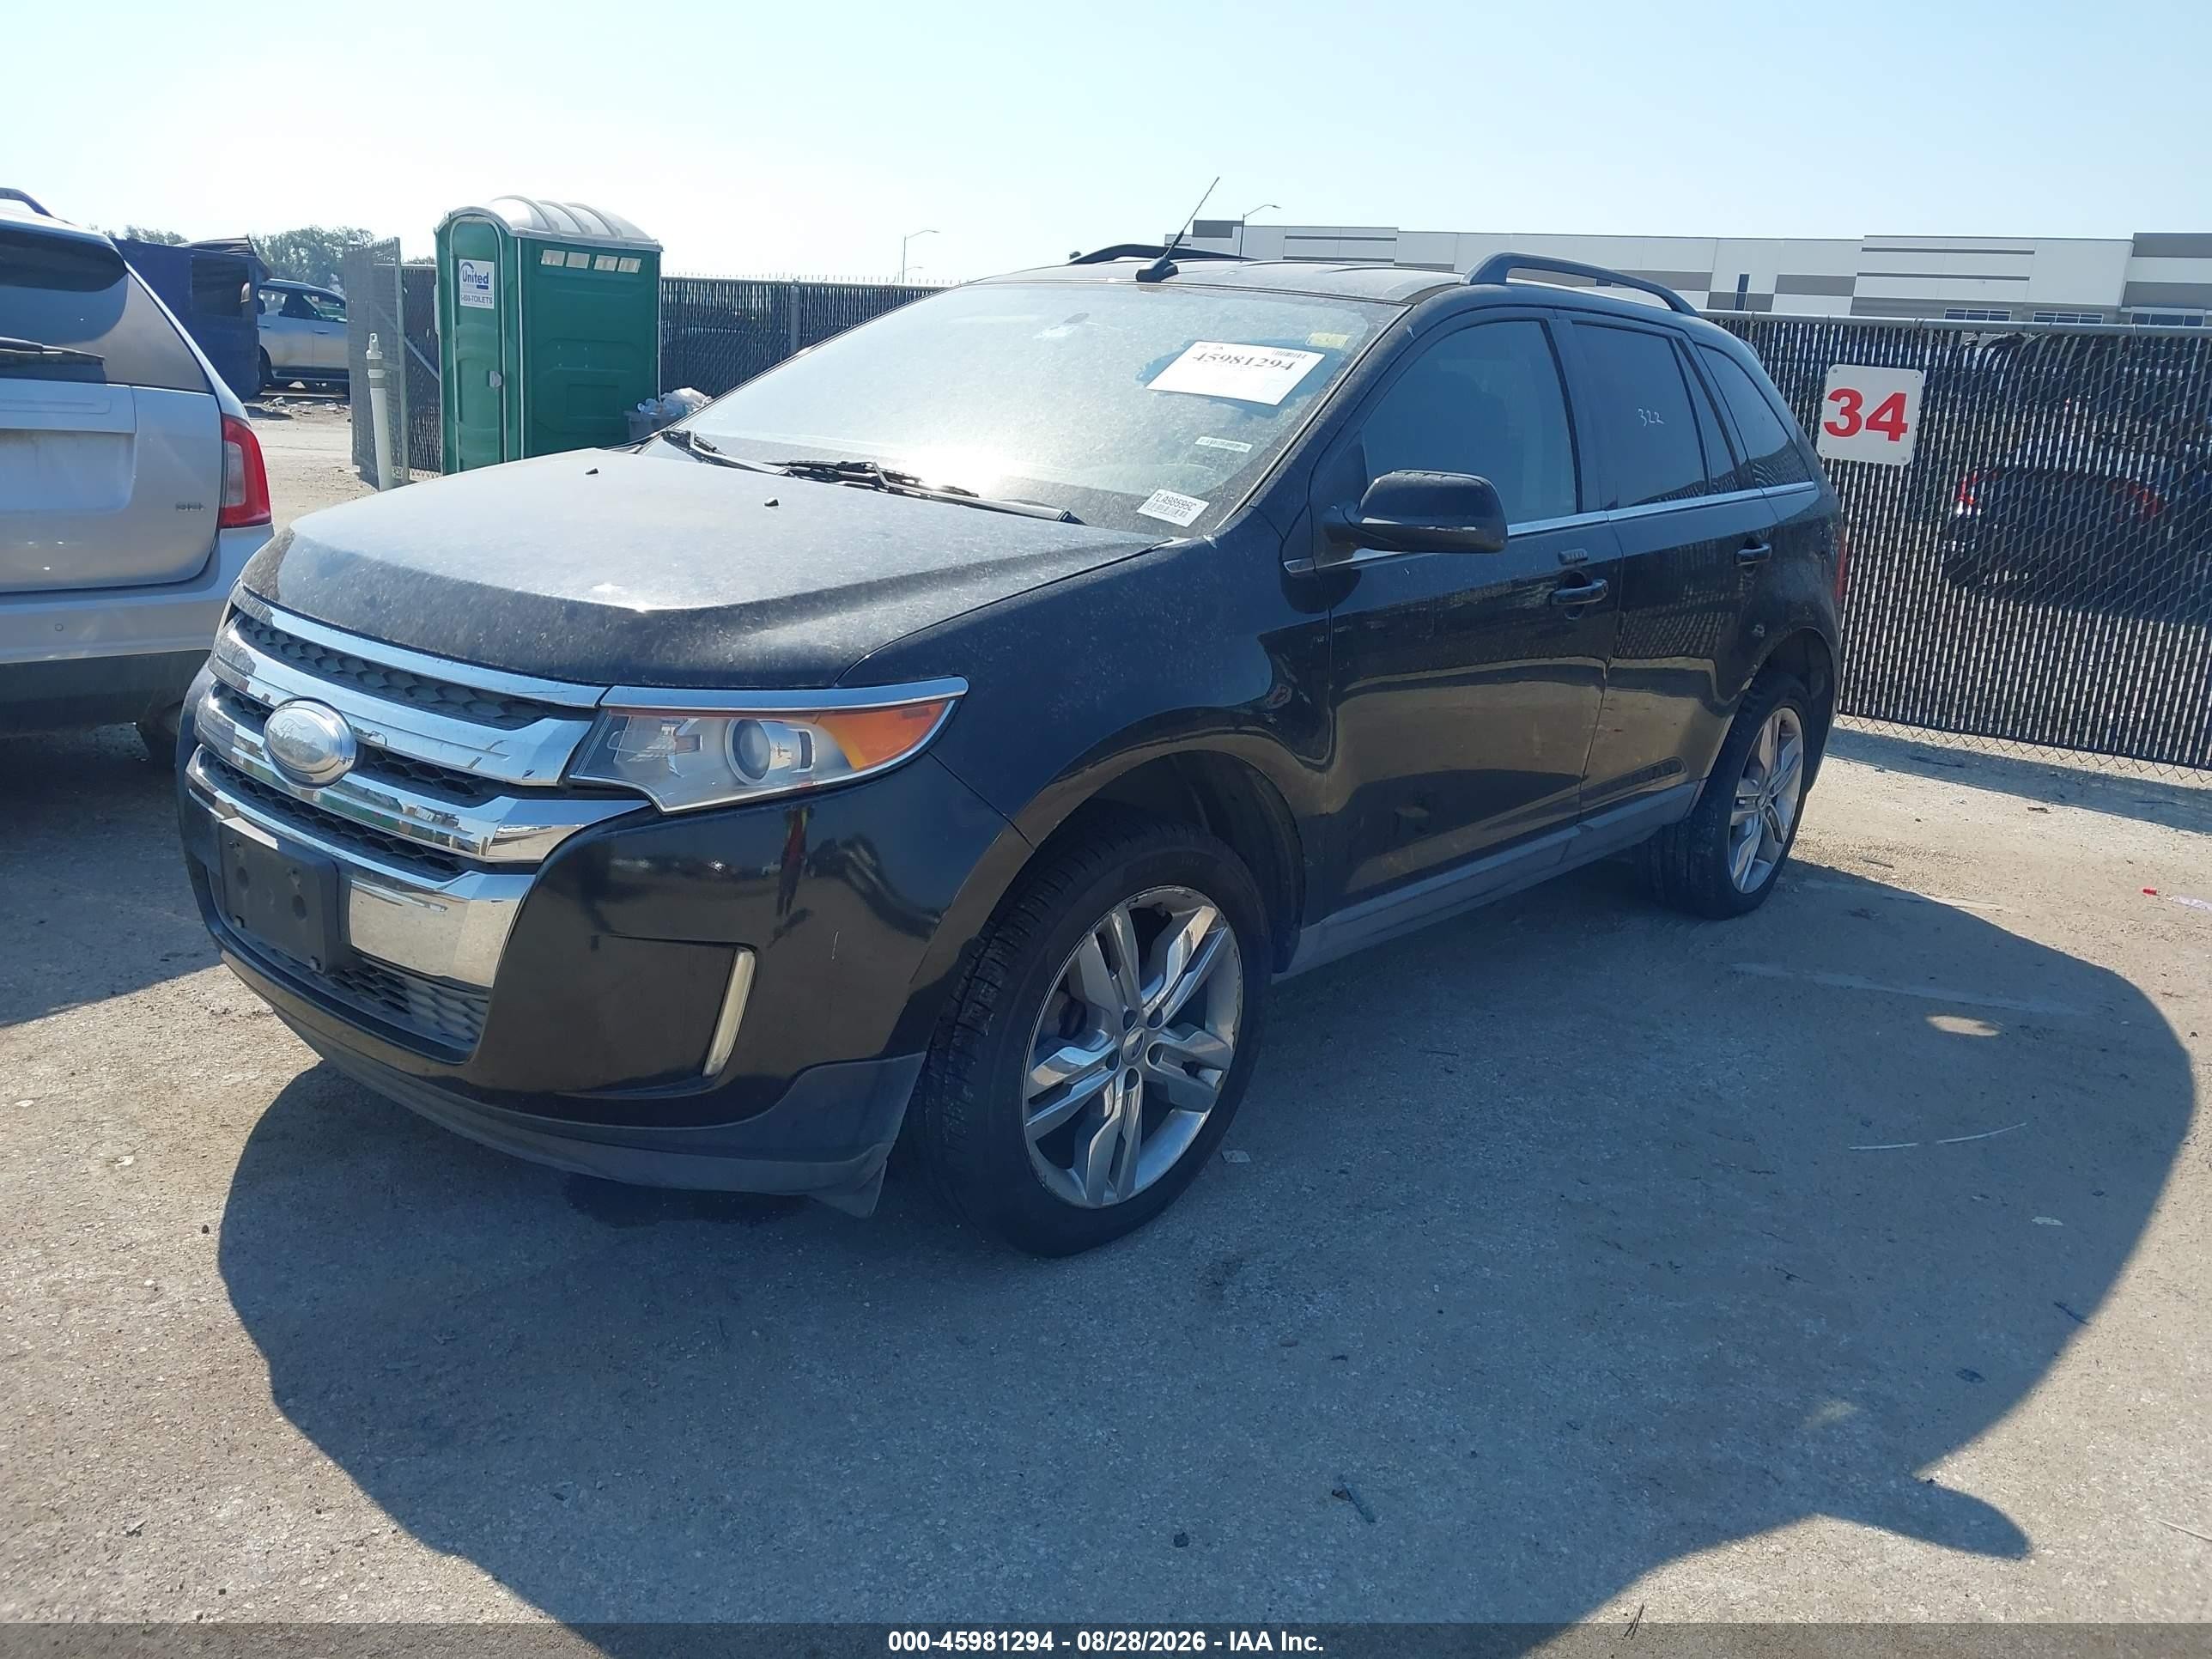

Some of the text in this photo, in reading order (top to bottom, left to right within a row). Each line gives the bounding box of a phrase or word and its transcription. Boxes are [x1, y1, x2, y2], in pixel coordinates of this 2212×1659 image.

[462, 269, 489, 284] United
[1193, 352, 1296, 370] 45981294
[1638, 408, 1664, 427] 322
[1823, 387, 1909, 442] 34
